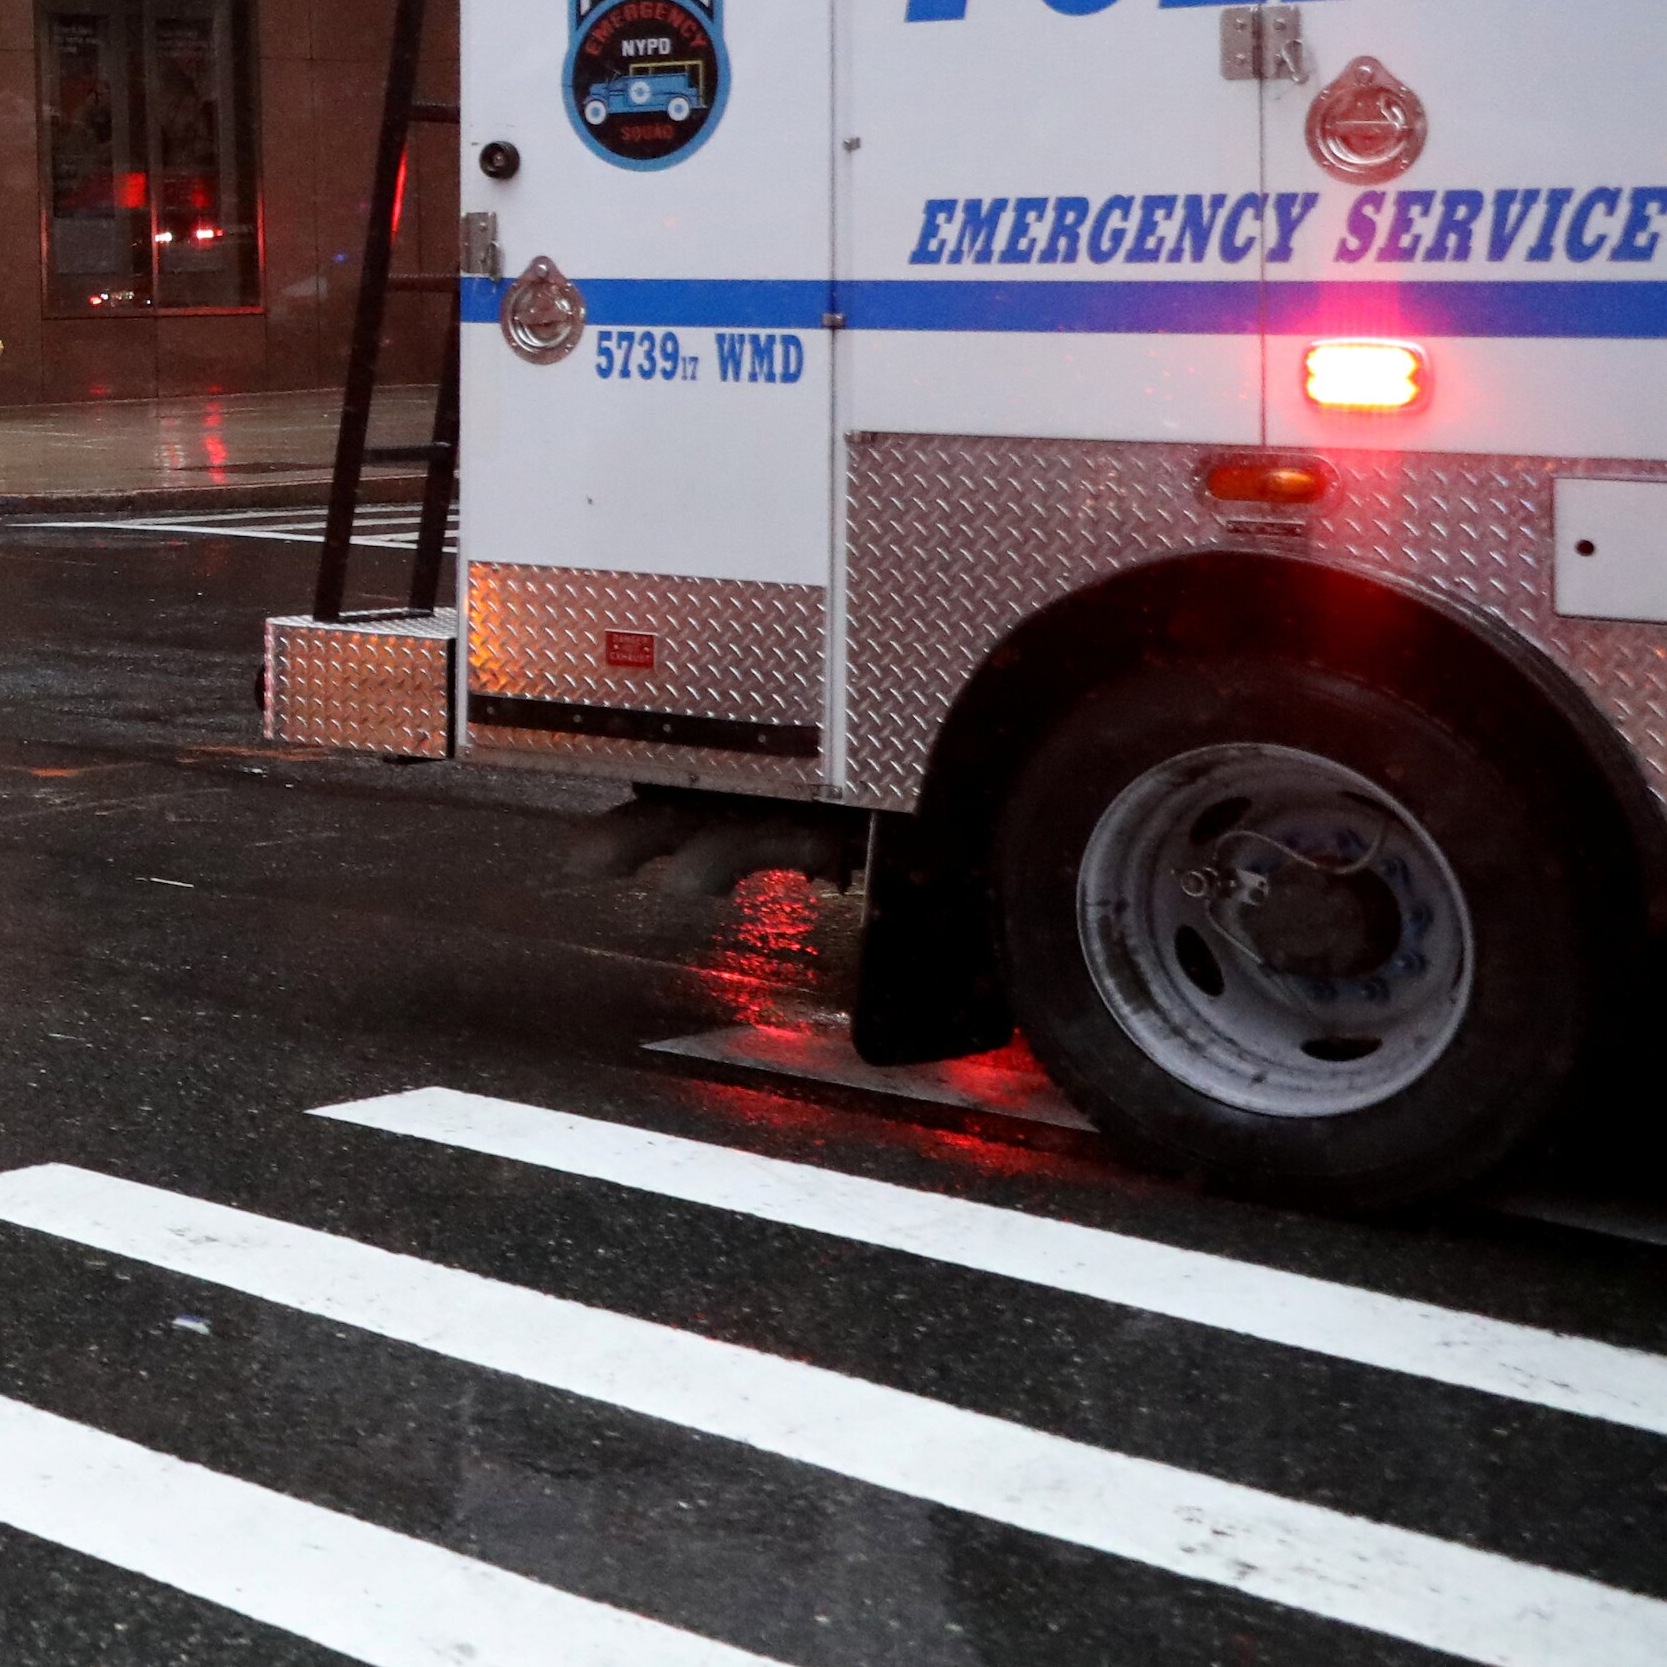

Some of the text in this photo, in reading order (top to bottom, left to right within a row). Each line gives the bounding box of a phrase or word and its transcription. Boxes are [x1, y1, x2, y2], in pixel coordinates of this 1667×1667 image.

[585, 1, 707, 56] EMERGENCY
[621, 38, 671, 57] NYPD
[909, 186, 1667, 265] EMERGENCY SERVICE
[595, 330, 679, 380] 5739
[715, 332, 804, 384] WMD
